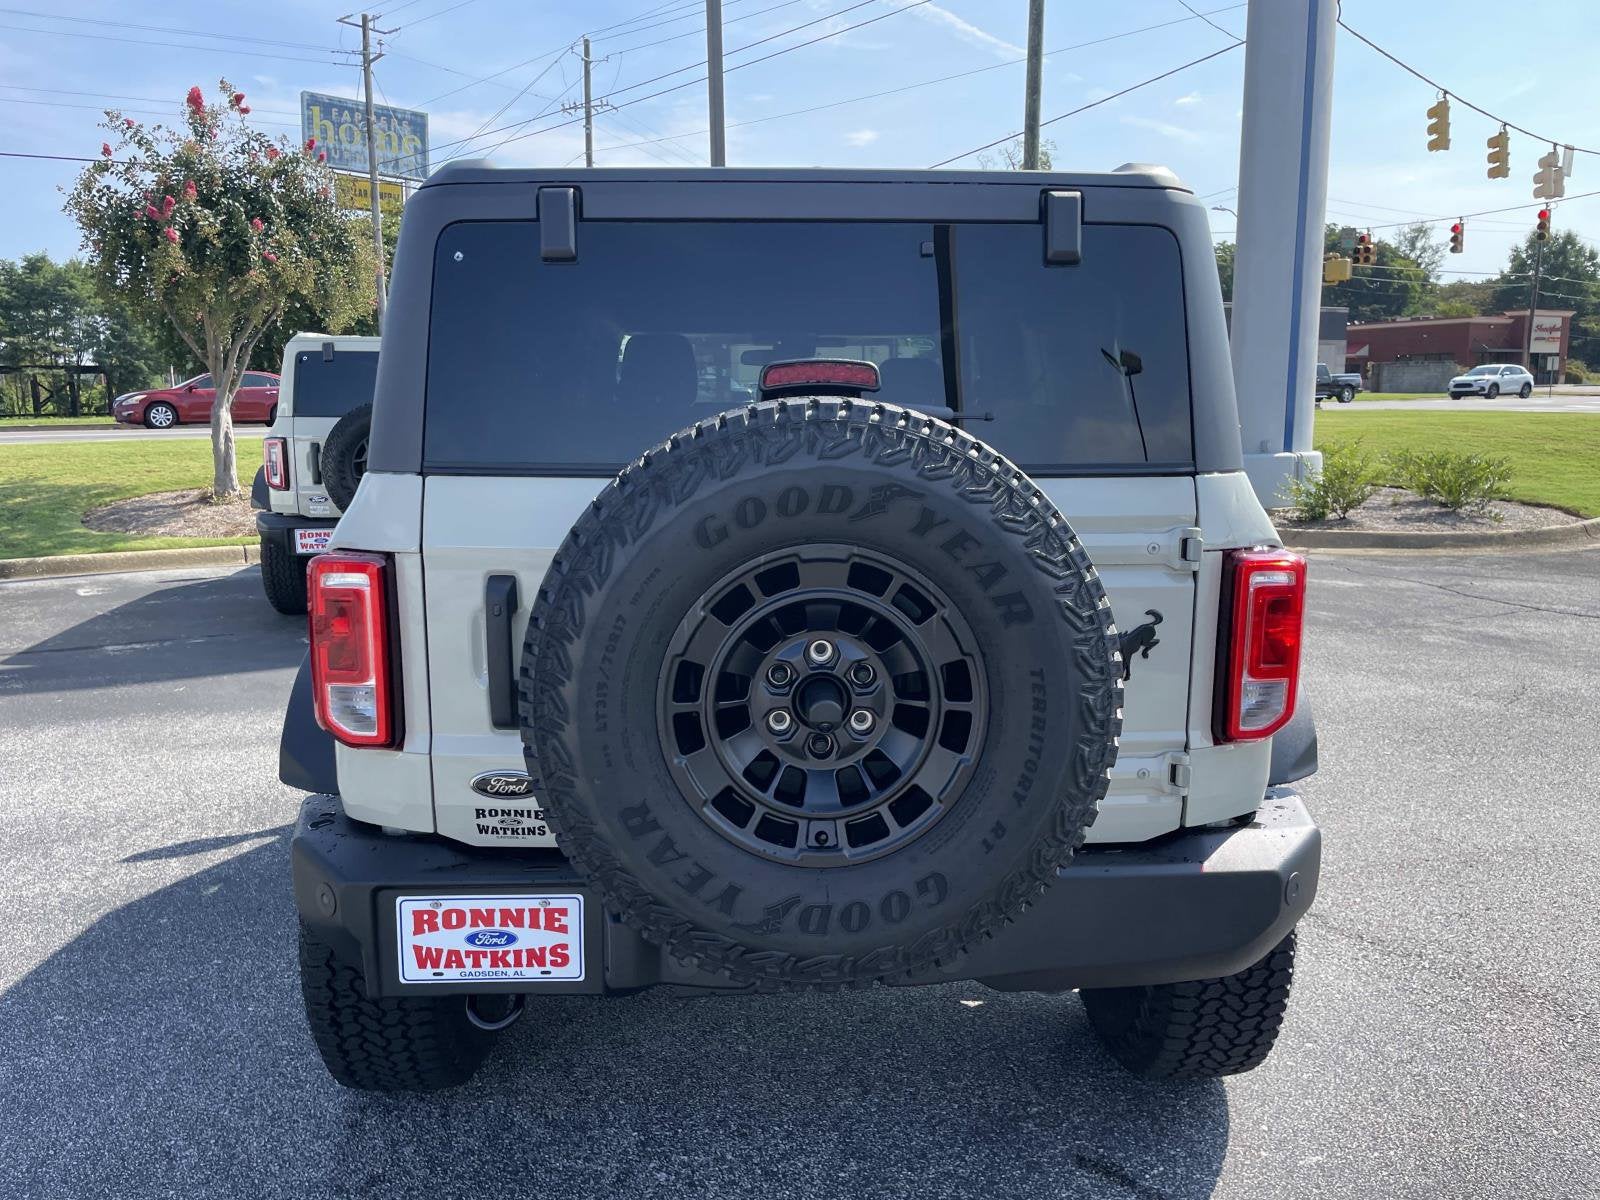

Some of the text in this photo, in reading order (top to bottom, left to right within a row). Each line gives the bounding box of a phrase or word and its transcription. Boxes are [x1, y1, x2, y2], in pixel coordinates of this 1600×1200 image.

[1013, 667, 1046, 807] TERRITORY
[487, 775, 528, 794] Ford
[475, 808, 545, 821] RONNIE
[476, 823, 546, 836] WATKINS
[412, 908, 568, 936] RONNIE
[475, 930, 508, 945] Ford
[412, 944, 570, 970] WATKINS
